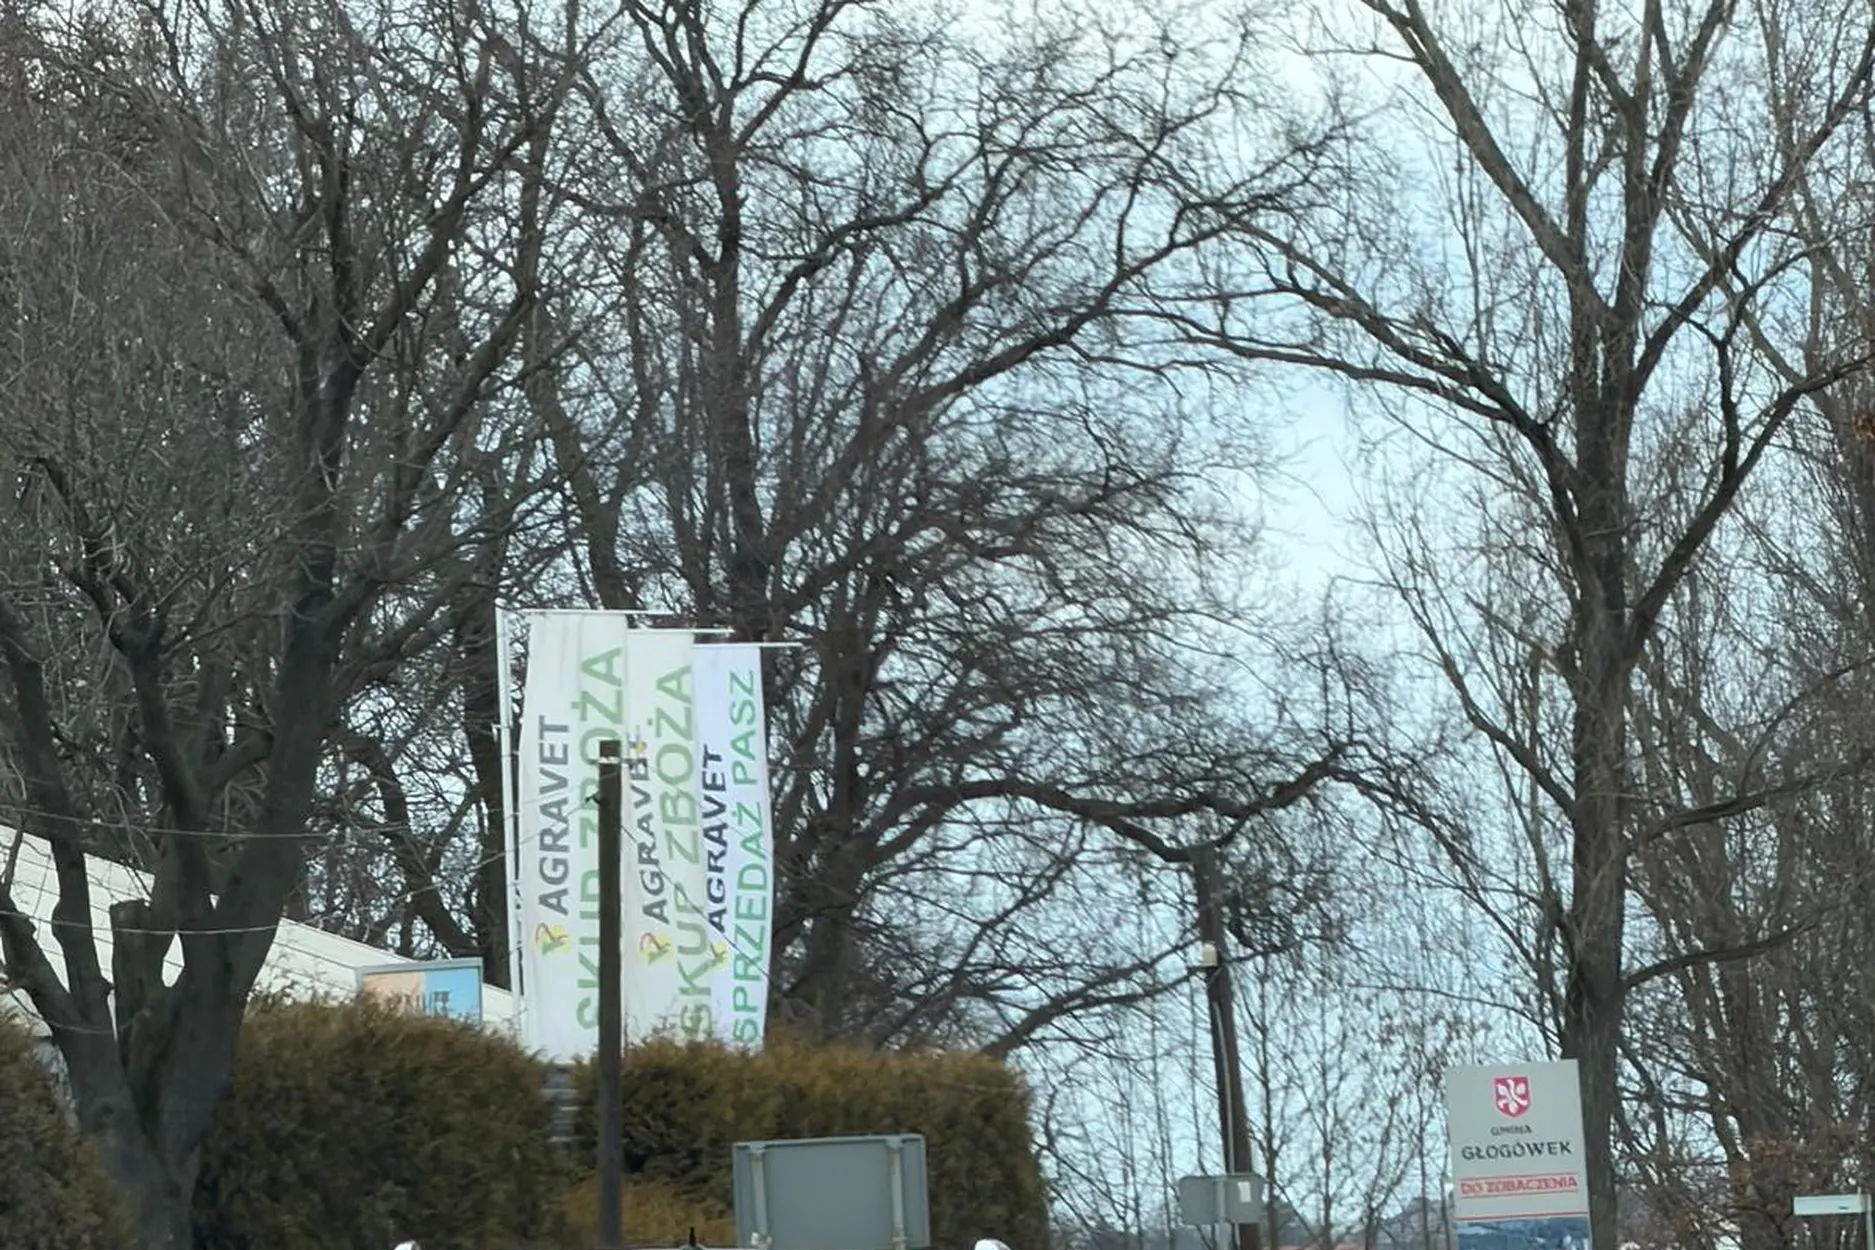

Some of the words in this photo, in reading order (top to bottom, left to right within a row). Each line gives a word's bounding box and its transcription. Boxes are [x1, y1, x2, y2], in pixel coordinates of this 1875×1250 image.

[647, 664, 700, 866] ZBOŻA
[729, 670, 758, 787] PASZ
[538, 715, 570, 916] AGRAVET
[702, 744, 729, 934] AGRAVET
[674, 881, 713, 1038] SKUP
[731, 801, 768, 1043] SPRZEDAŻ
[1461, 1140, 1572, 1161] GŁOGÓWEK
[1461, 1182, 1481, 1194] DO
